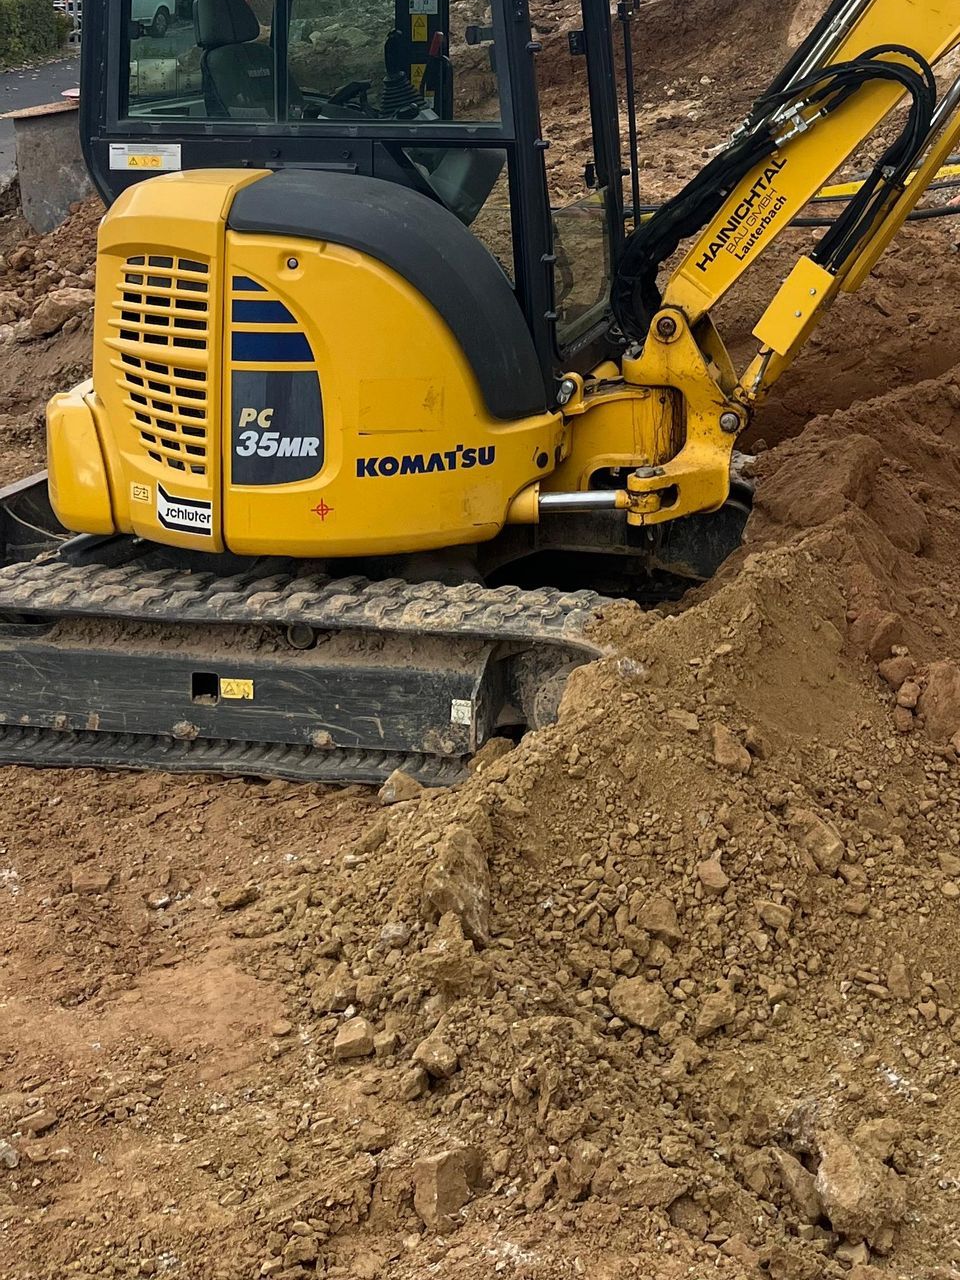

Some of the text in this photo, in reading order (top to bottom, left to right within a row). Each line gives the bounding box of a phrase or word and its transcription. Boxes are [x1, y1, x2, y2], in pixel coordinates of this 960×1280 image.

[695, 158, 788, 272] HAINICHTAL
[726, 187, 777, 254] BAU GMBH
[734, 195, 787, 261] Lauterbach
[238, 408, 274, 428] PC
[236, 430, 320, 458] 35MR
[357, 444, 495, 477] KOMATSU
